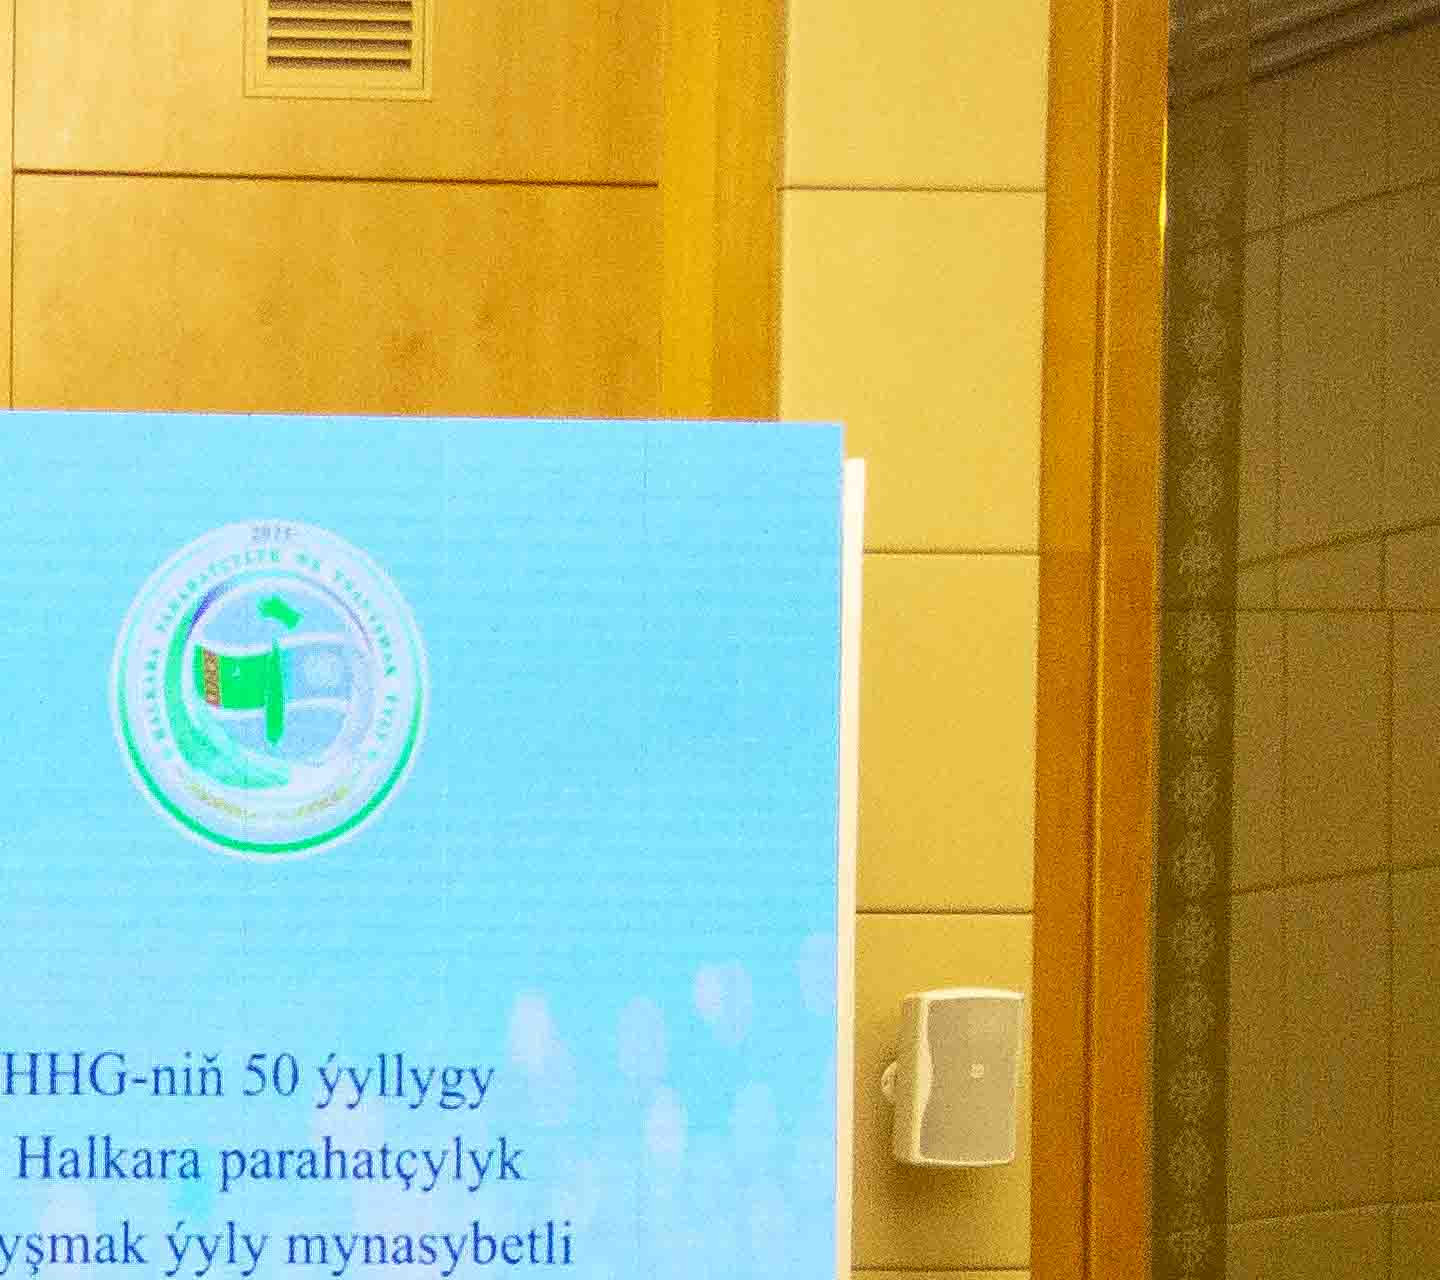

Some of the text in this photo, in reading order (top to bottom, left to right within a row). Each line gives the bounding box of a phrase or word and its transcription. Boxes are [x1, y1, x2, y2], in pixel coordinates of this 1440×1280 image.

[243, 1053, 300, 1097] 50
[317, 1051, 495, 1110] ýyllygy
[18, 1134, 203, 1182] Halkara
[219, 1135, 523, 1193] parahatçylyk
[165, 1219, 268, 1278] ýyly
[287, 1220, 572, 1278] mynasybetli
